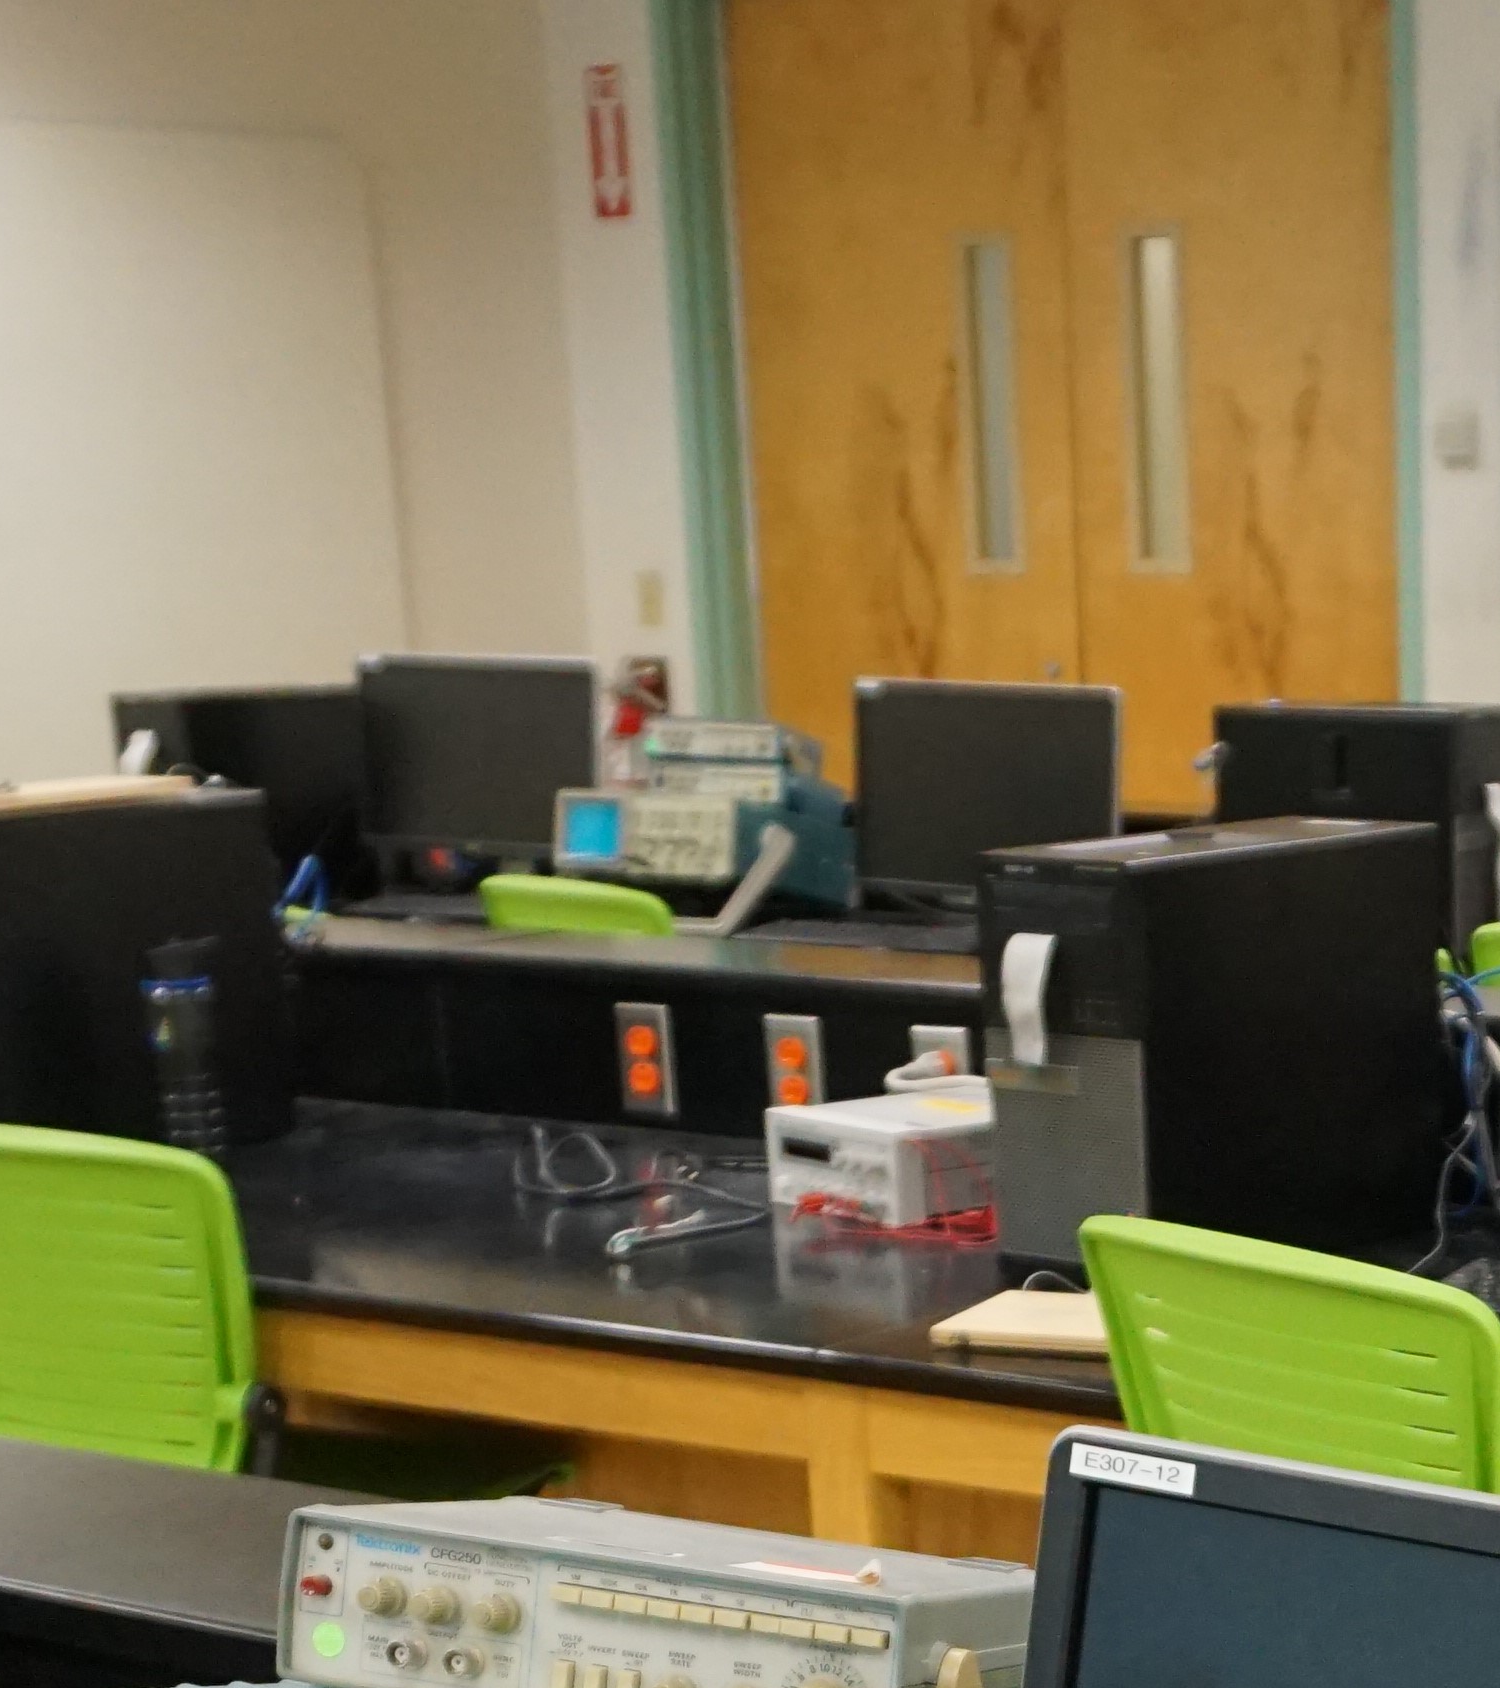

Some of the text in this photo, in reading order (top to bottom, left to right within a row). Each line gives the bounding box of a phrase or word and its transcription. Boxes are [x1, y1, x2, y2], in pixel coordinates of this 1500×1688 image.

[1083, 1450, 1181, 1484] E307-12
[356, 1533, 421, 1556] Tektronix
[430, 1546, 483, 1565] CFG250
